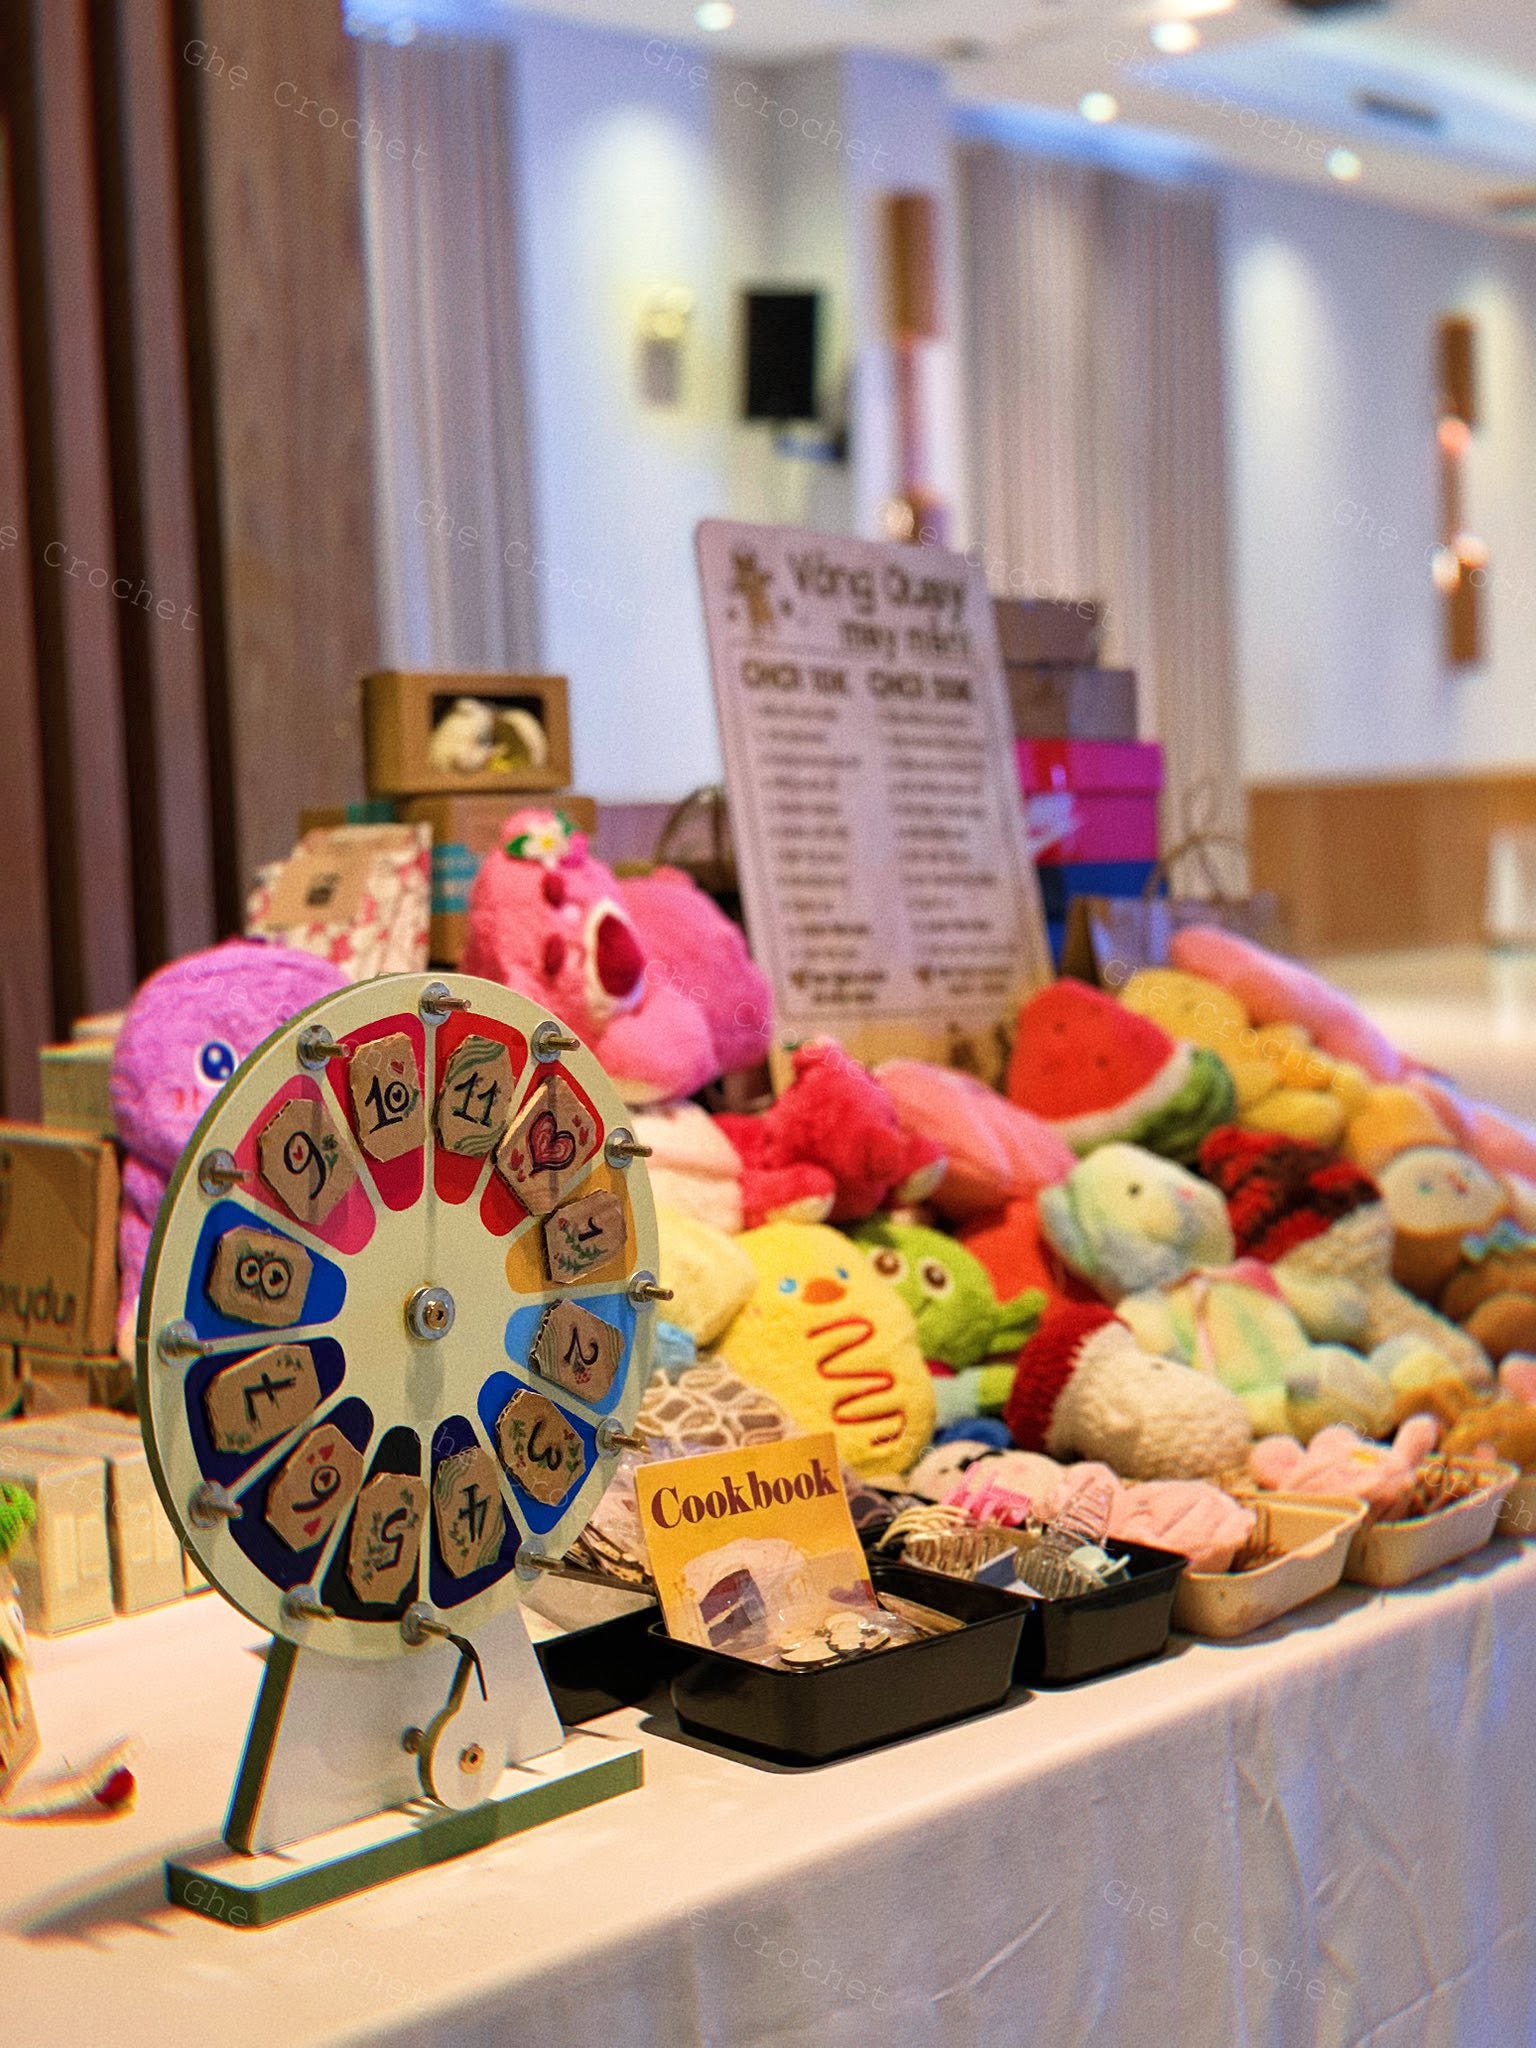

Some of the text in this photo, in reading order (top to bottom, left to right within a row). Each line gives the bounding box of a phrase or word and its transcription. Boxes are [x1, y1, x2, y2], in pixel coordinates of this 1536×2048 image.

[365, 1075, 410, 1134] 10
[453, 1072, 498, 1127] 11
[284, 1131, 326, 1200] 9
[237, 1256, 291, 1300] 8
[563, 1326, 599, 1366] 2
[244, 1372, 297, 1424] 7
[527, 1420, 562, 1471] 3
[458, 1483, 488, 1543] 4
[651, 1458, 839, 1529] Cookbook
[375, 1507, 408, 1573] 5
